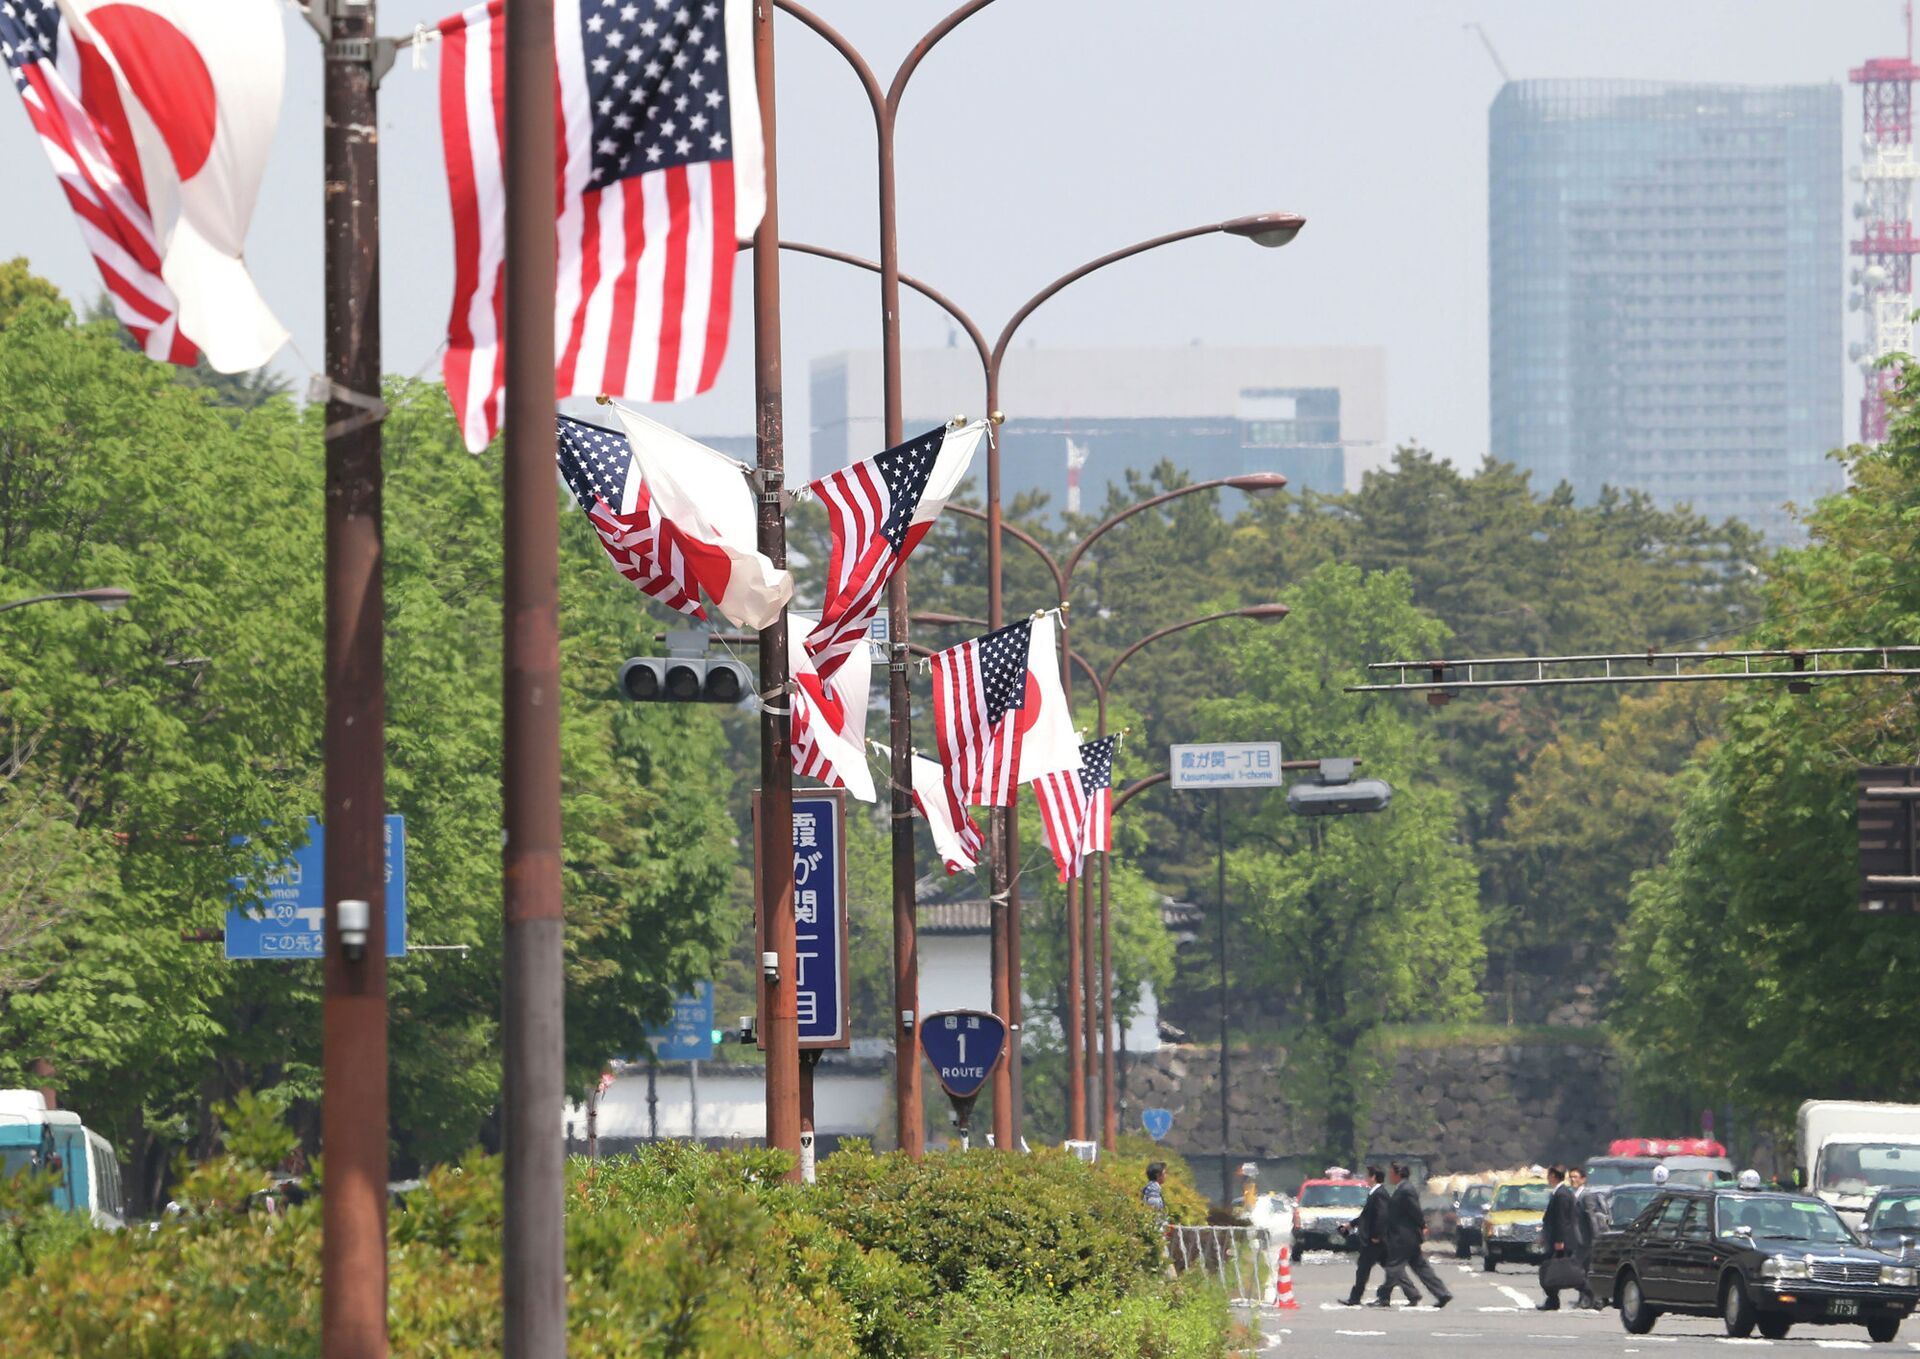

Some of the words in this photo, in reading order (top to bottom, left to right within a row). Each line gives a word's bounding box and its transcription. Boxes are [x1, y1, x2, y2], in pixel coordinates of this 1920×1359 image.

[277, 905, 294, 919] 20
[957, 1033, 966, 1064] 1
[942, 1066, 985, 1078] ROUTE
